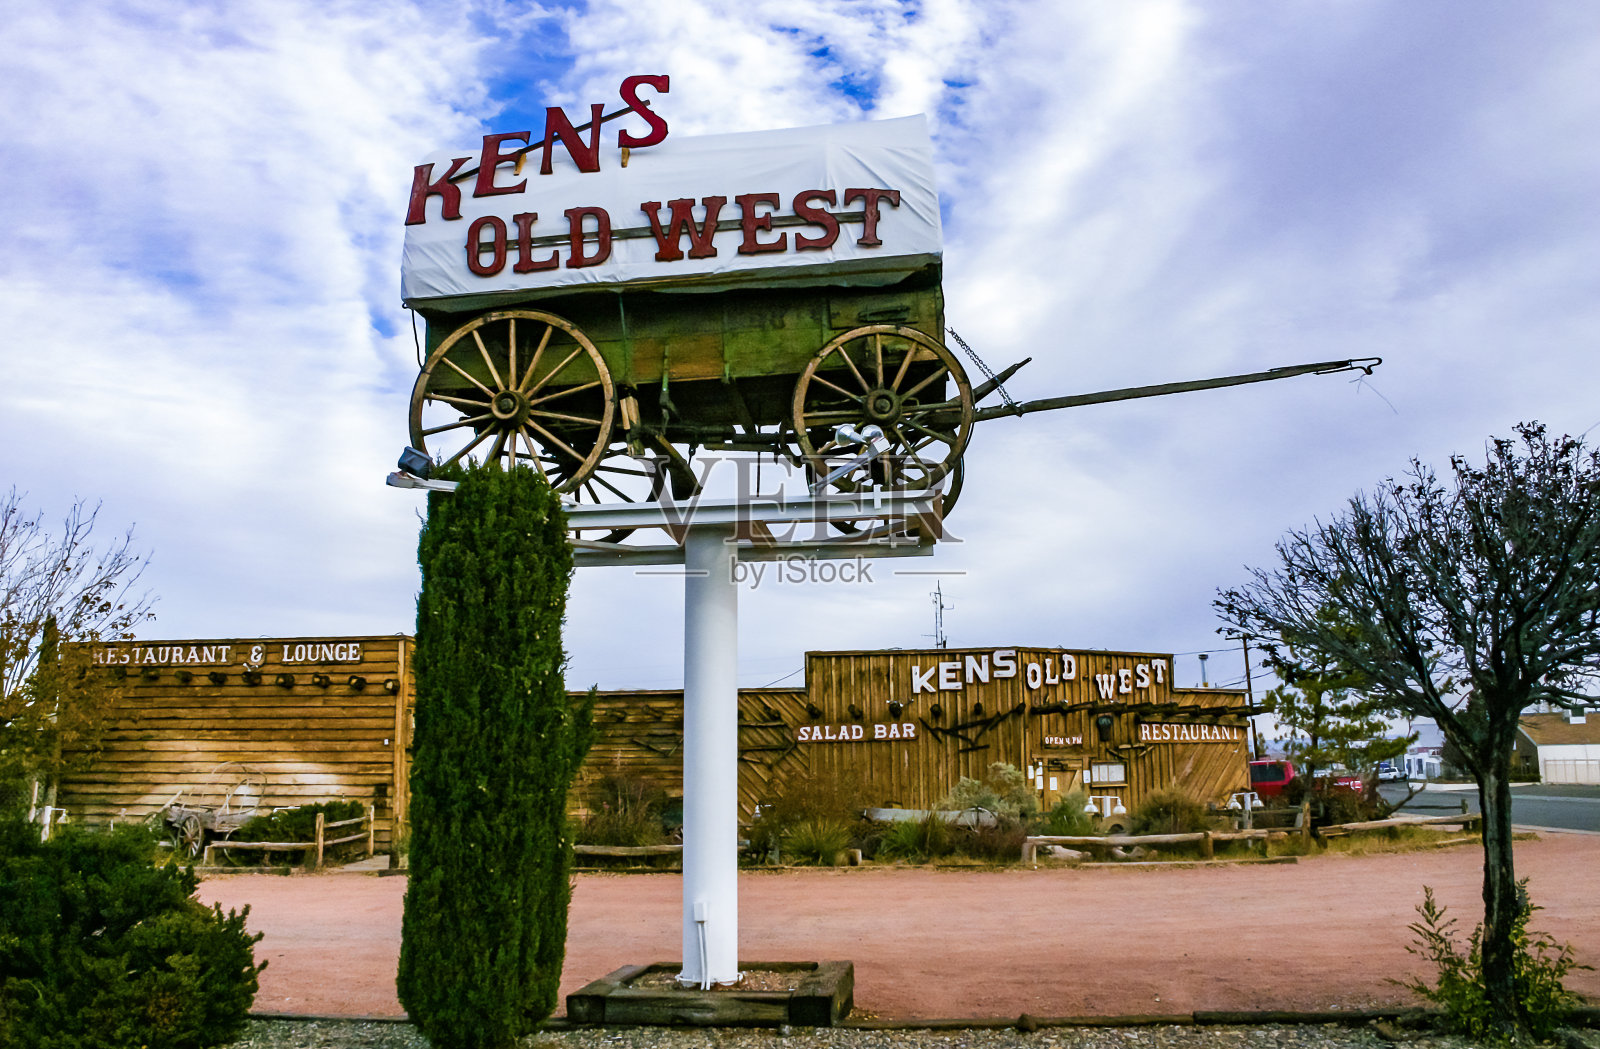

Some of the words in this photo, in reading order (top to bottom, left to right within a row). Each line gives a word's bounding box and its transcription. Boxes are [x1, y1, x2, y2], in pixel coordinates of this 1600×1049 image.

[404, 75, 670, 225] KENS
[465, 206, 612, 276] OLD
[640, 188, 900, 262] WEST
[282, 643, 361, 662] LOUNGE
[911, 650, 1017, 694] KENS
[1026, 653, 1077, 690] OLD
[1095, 658, 1166, 700] WEST
[798, 725, 863, 742] SALAD
[874, 723, 916, 740] BAR
[1045, 736, 1064, 744] OPEN
